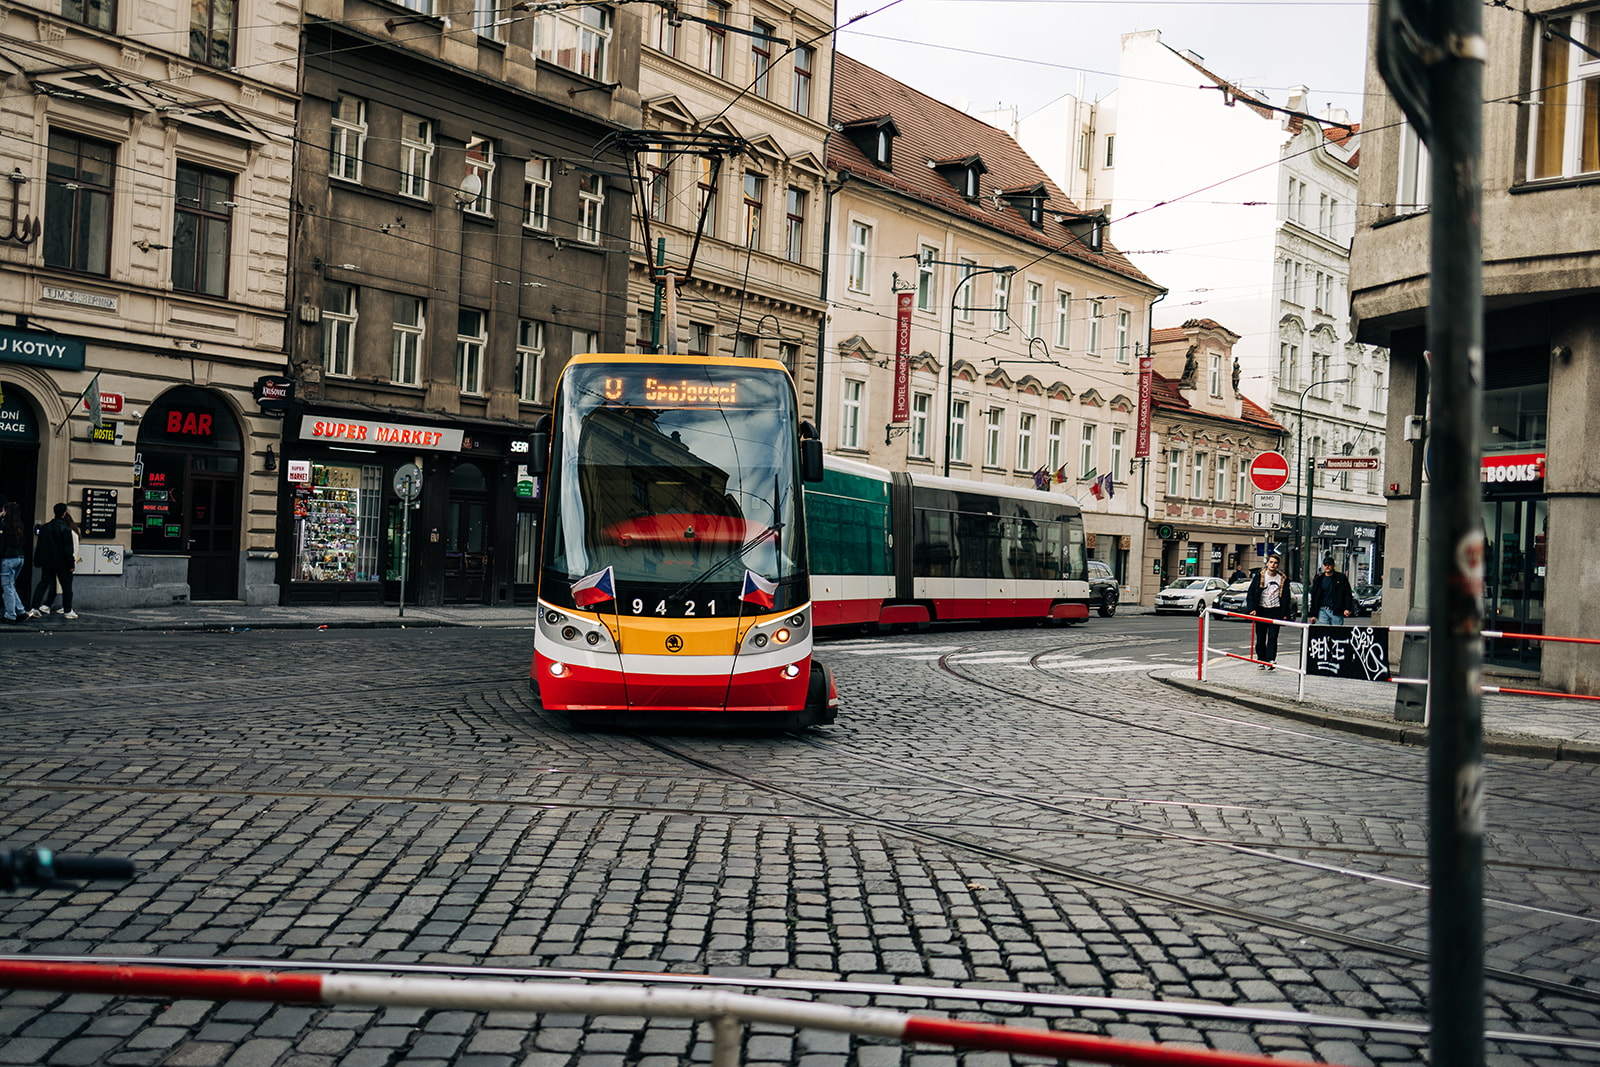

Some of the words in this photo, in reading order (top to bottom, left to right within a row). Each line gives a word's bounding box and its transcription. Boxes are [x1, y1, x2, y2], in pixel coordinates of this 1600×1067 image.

[900, 316, 908, 345] COURT
[12, 340, 66, 358] KOTVY
[898, 385, 906, 410] HOTEL
[1141, 376, 1149, 398] COURT
[0, 410, 20, 420] DNÍ
[167, 411, 212, 435] BAR
[1140, 399, 1148, 427] GARDEN
[94, 428, 114, 440] HOSTEL
[313, 421, 368, 440] SUPER
[376, 427, 442, 446] MARKET
[149, 473, 165, 481] BAR
[1487, 463, 1535, 482] BOOKS
